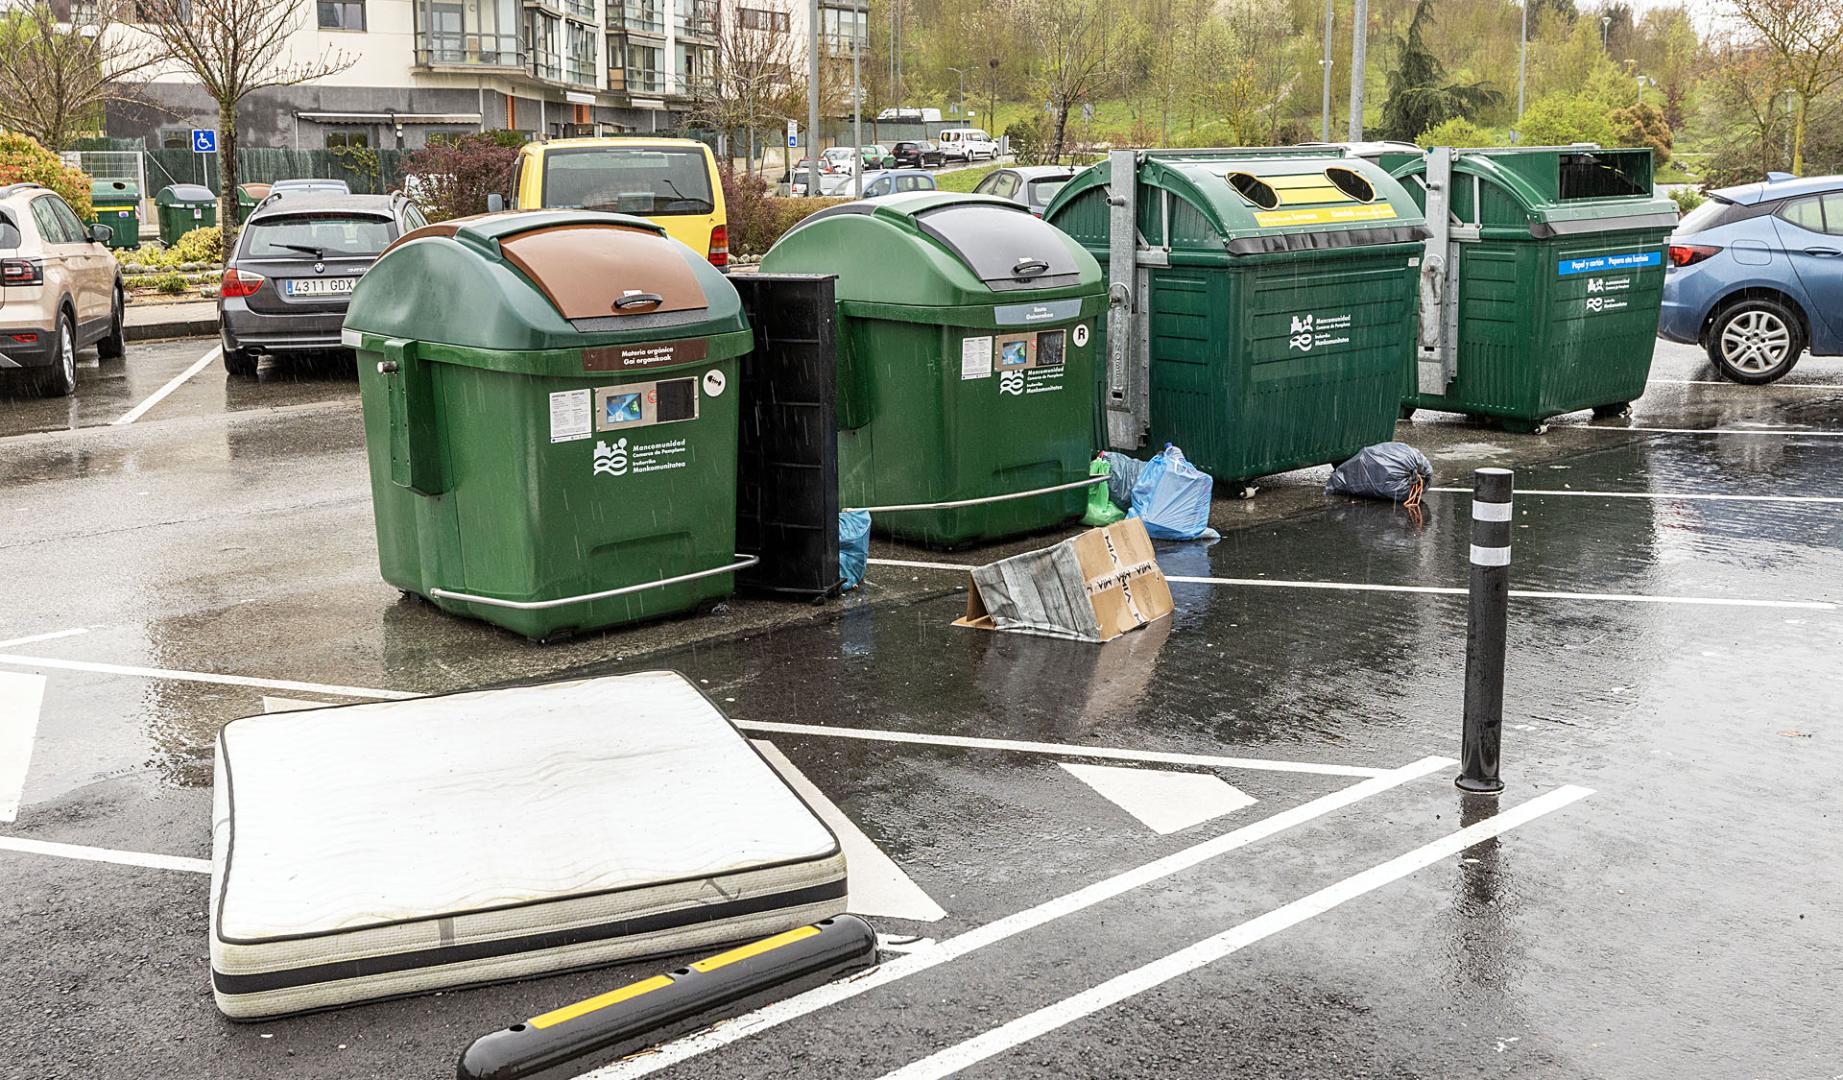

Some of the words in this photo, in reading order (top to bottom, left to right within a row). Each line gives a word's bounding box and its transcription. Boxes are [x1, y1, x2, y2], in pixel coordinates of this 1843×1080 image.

[1572, 259, 1585, 271] Papel
[294, 280, 325, 293] 4311
[330, 279, 353, 291] GDX
[1077, 327, 1086, 340] R
[621, 349, 646, 358] Materia
[623, 357, 635, 365] Gai
[636, 354, 672, 365] organikoak
[632, 438, 686, 452] Mancomunidad
[632, 461, 686, 474] Mankomunitatea
